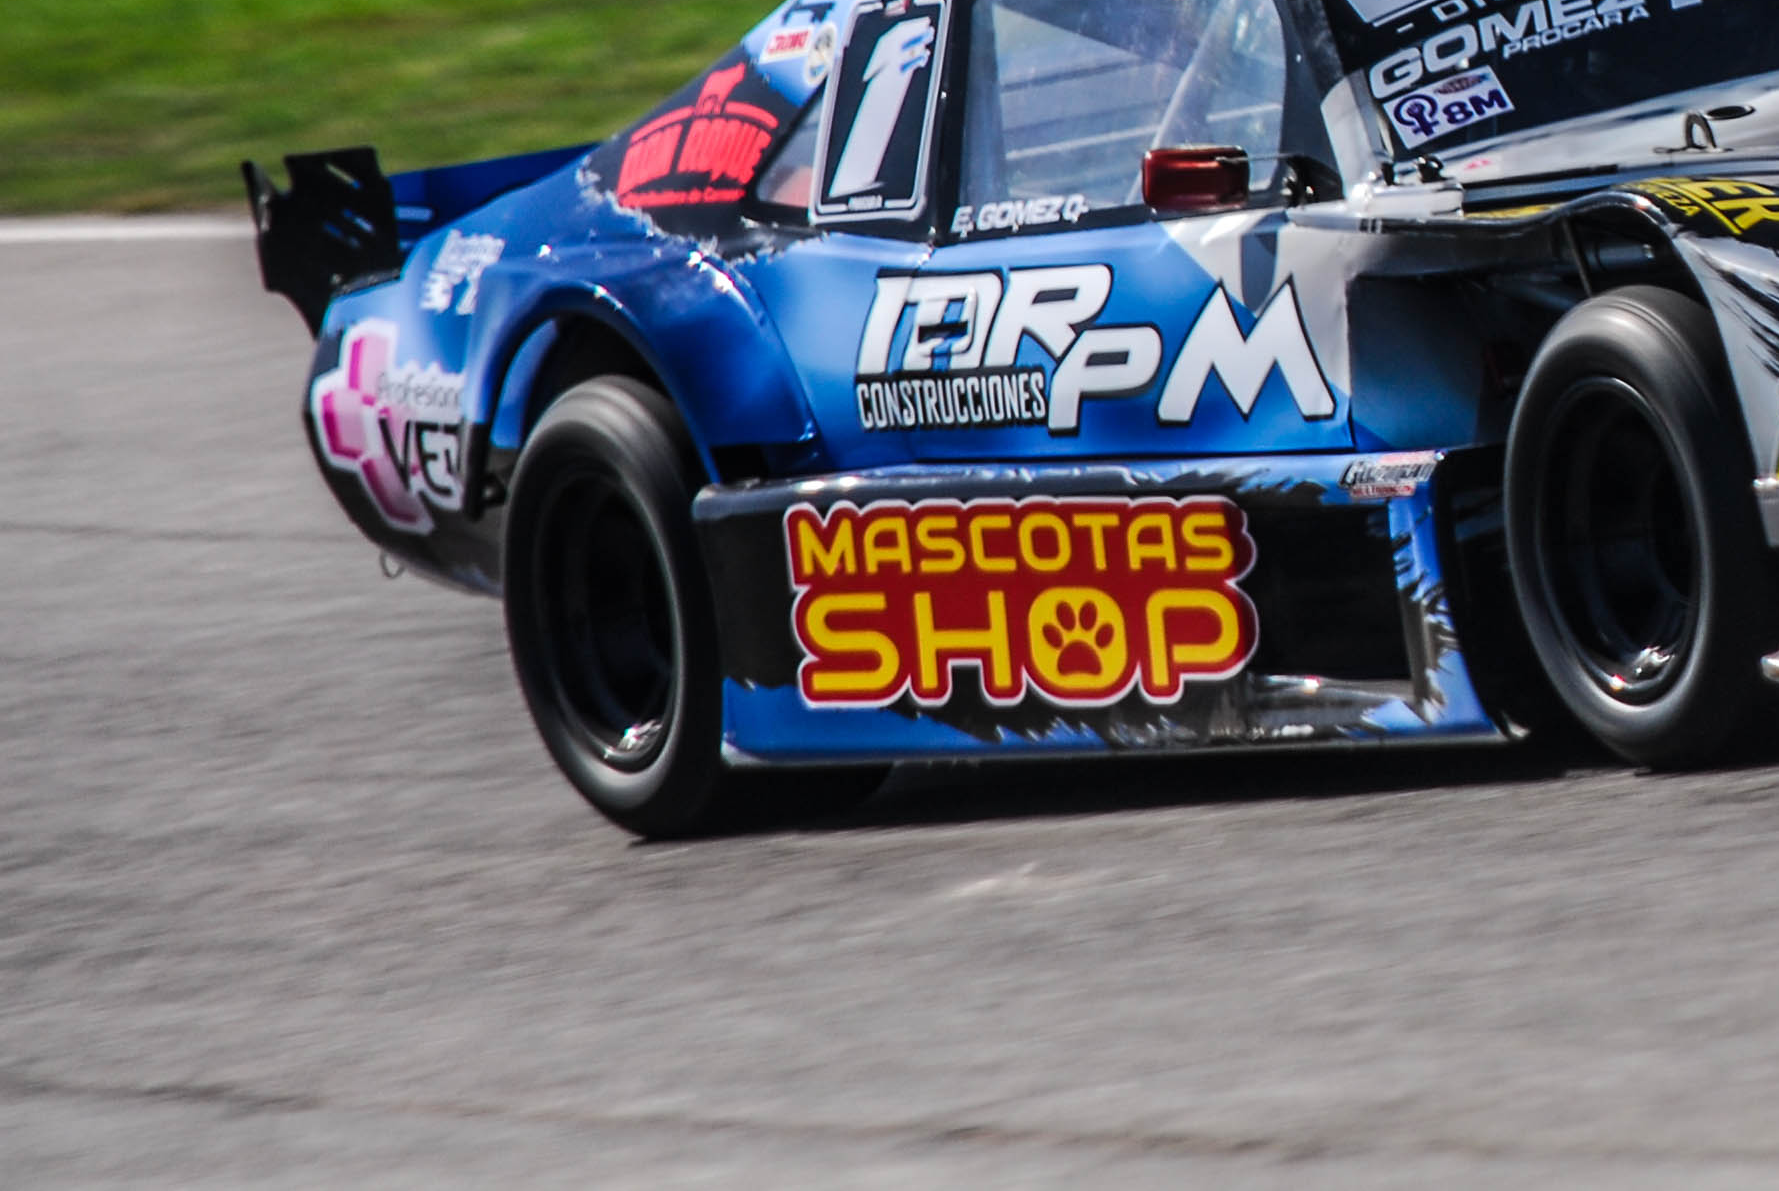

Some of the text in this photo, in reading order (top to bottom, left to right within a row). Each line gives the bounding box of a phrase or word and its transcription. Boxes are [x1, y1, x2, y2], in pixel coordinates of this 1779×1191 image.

[829, 16, 936, 198] 1
[1446, 89, 1510, 125] 8M
[976, 195, 1065, 231] GOMEZ
[857, 372, 1047, 429] CONSTRUCCIONES
[799, 513, 1234, 576] MASCOTAS
[806, 587, 1240, 693] SHOP
